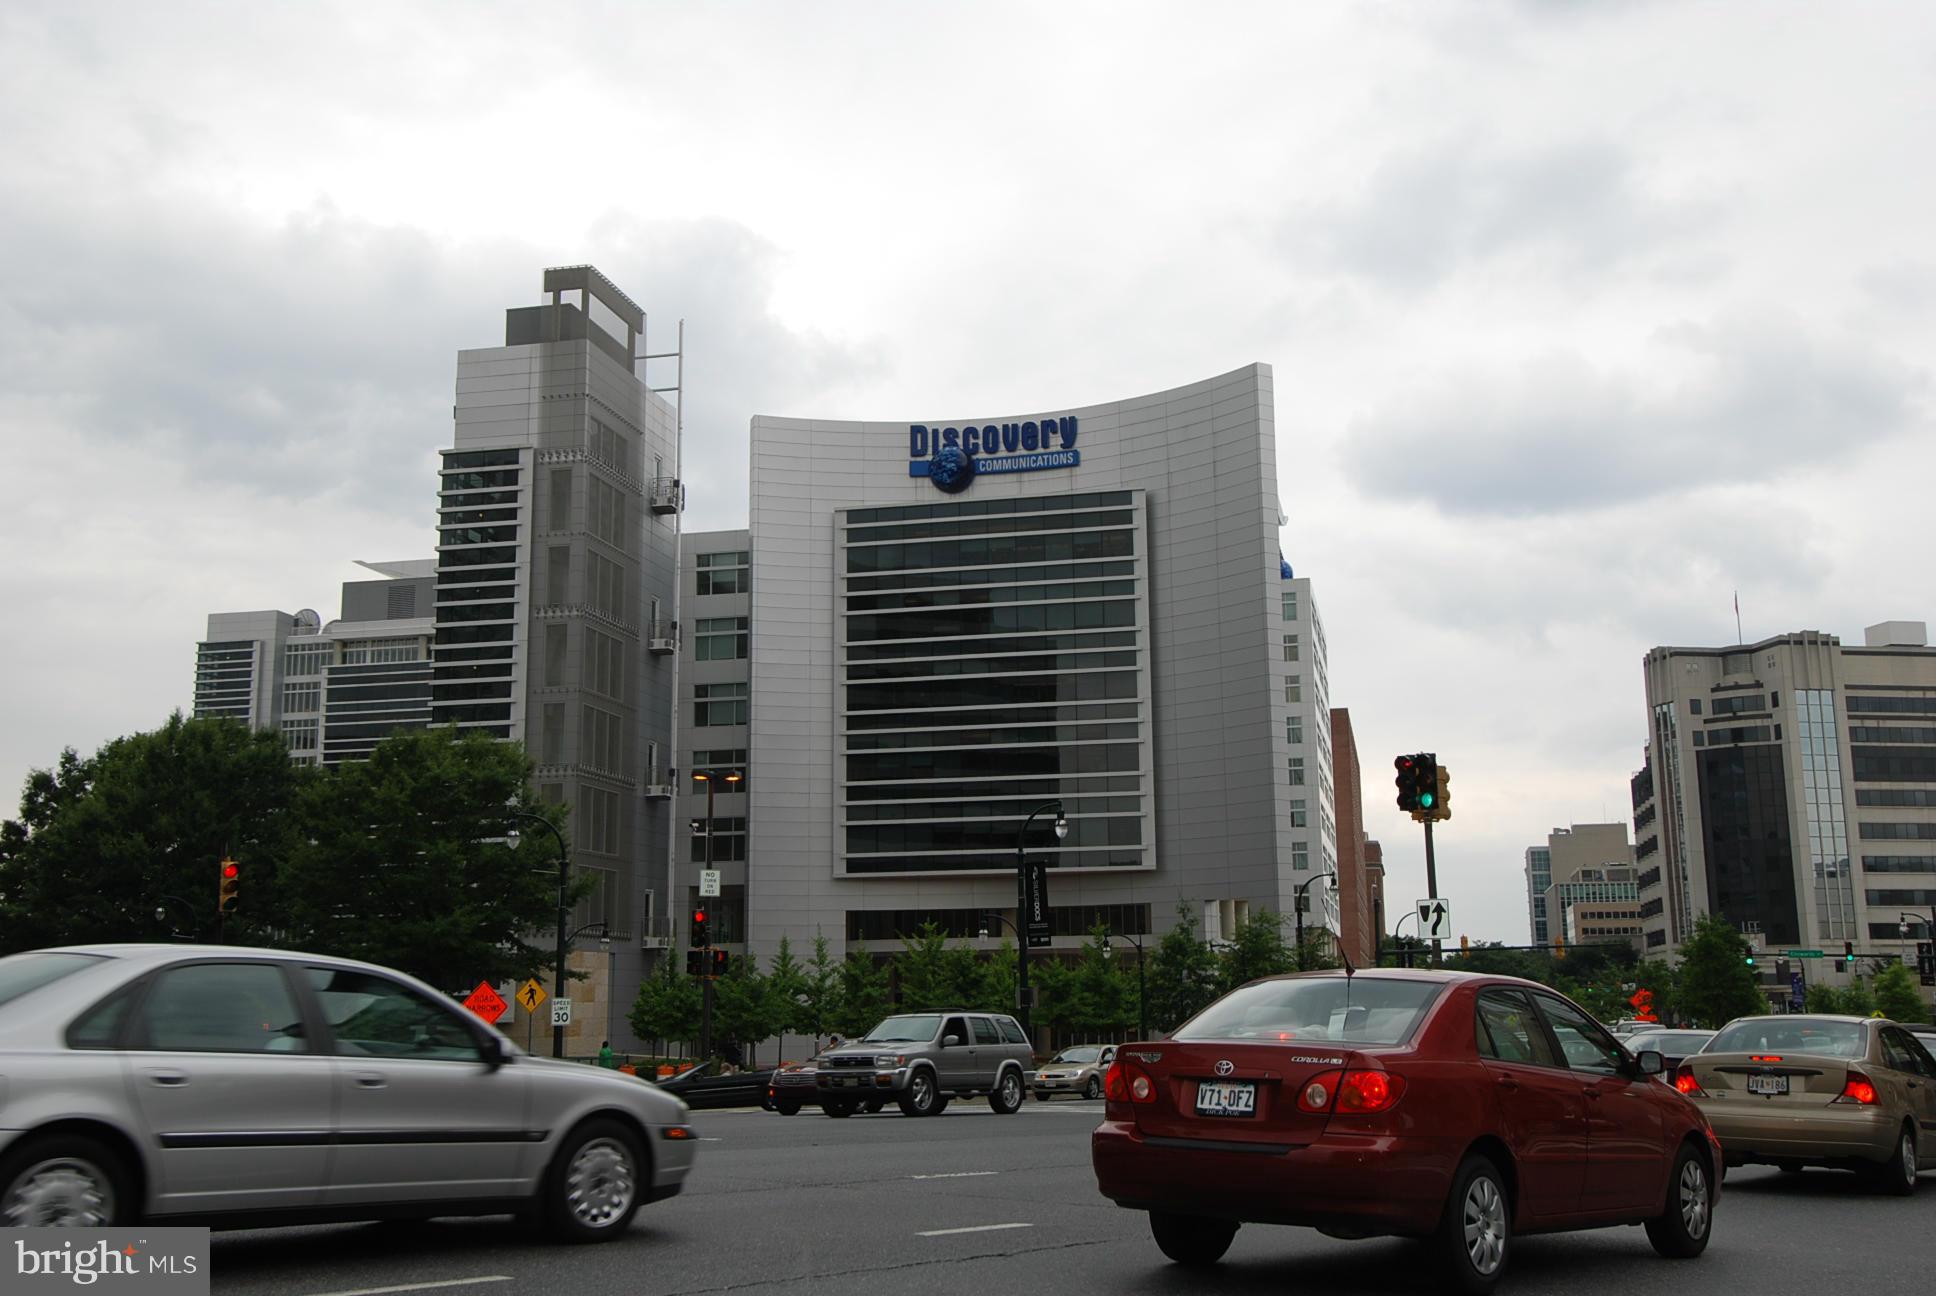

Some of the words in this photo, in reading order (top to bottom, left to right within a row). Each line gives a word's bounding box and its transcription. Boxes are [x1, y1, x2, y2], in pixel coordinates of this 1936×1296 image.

[979, 453, 1074, 473] COMMUNICATIONS
[553, 1012, 569, 1022] 30
[1290, 1056, 1330, 1064] COROLLA
